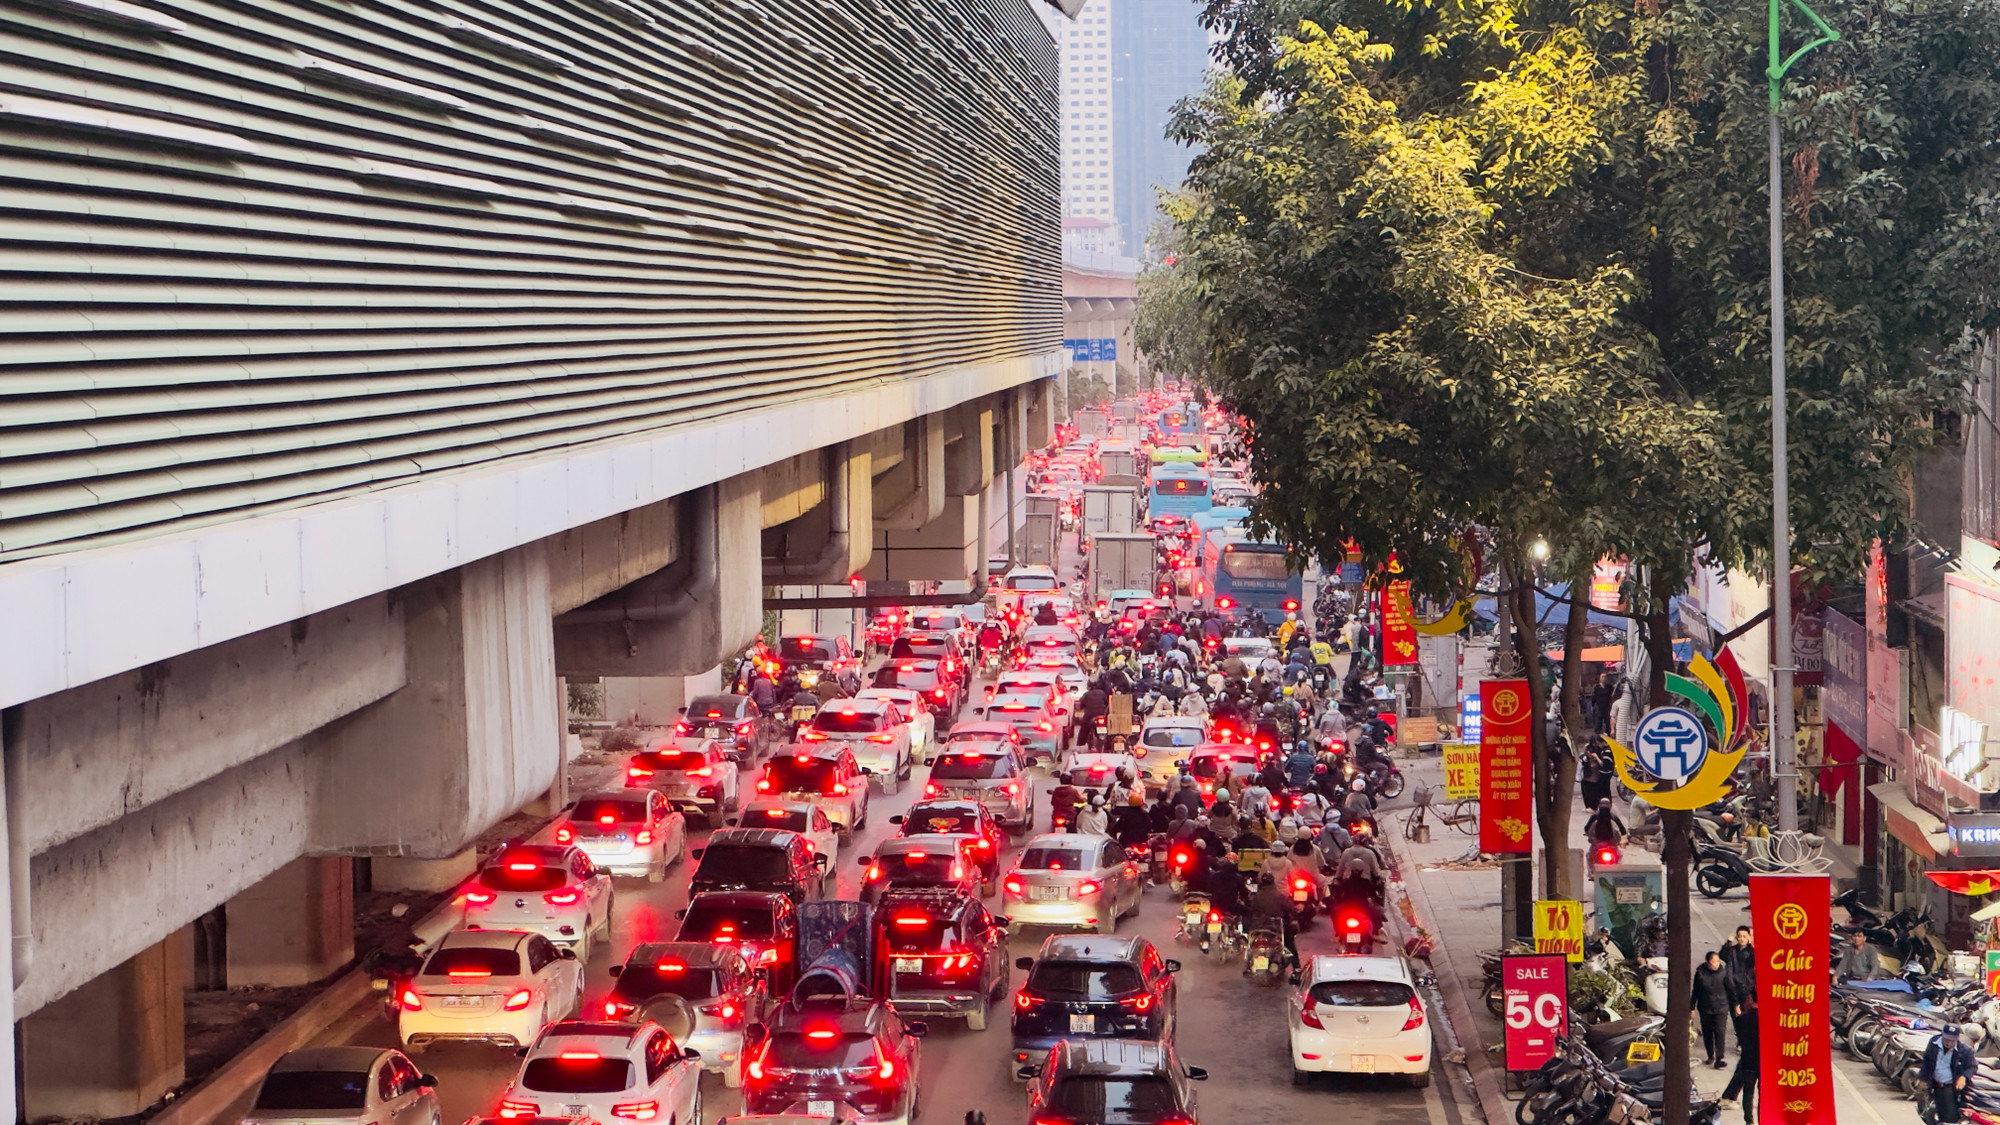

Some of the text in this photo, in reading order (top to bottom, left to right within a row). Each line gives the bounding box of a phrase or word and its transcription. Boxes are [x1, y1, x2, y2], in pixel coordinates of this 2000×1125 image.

[1447, 750, 1480, 765] SƠN HÀ
[1448, 768, 1465, 787] XE
[1547, 904, 1570, 931] TÔ
[1770, 948, 1814, 972] Chúc
[1516, 968, 1549, 980] SALE
[1771, 979, 1815, 1003] mừng
[1779, 1008, 1810, 1029] năm
[1782, 1034, 1809, 1057] mới
[1777, 1067, 1817, 1087] 2025
